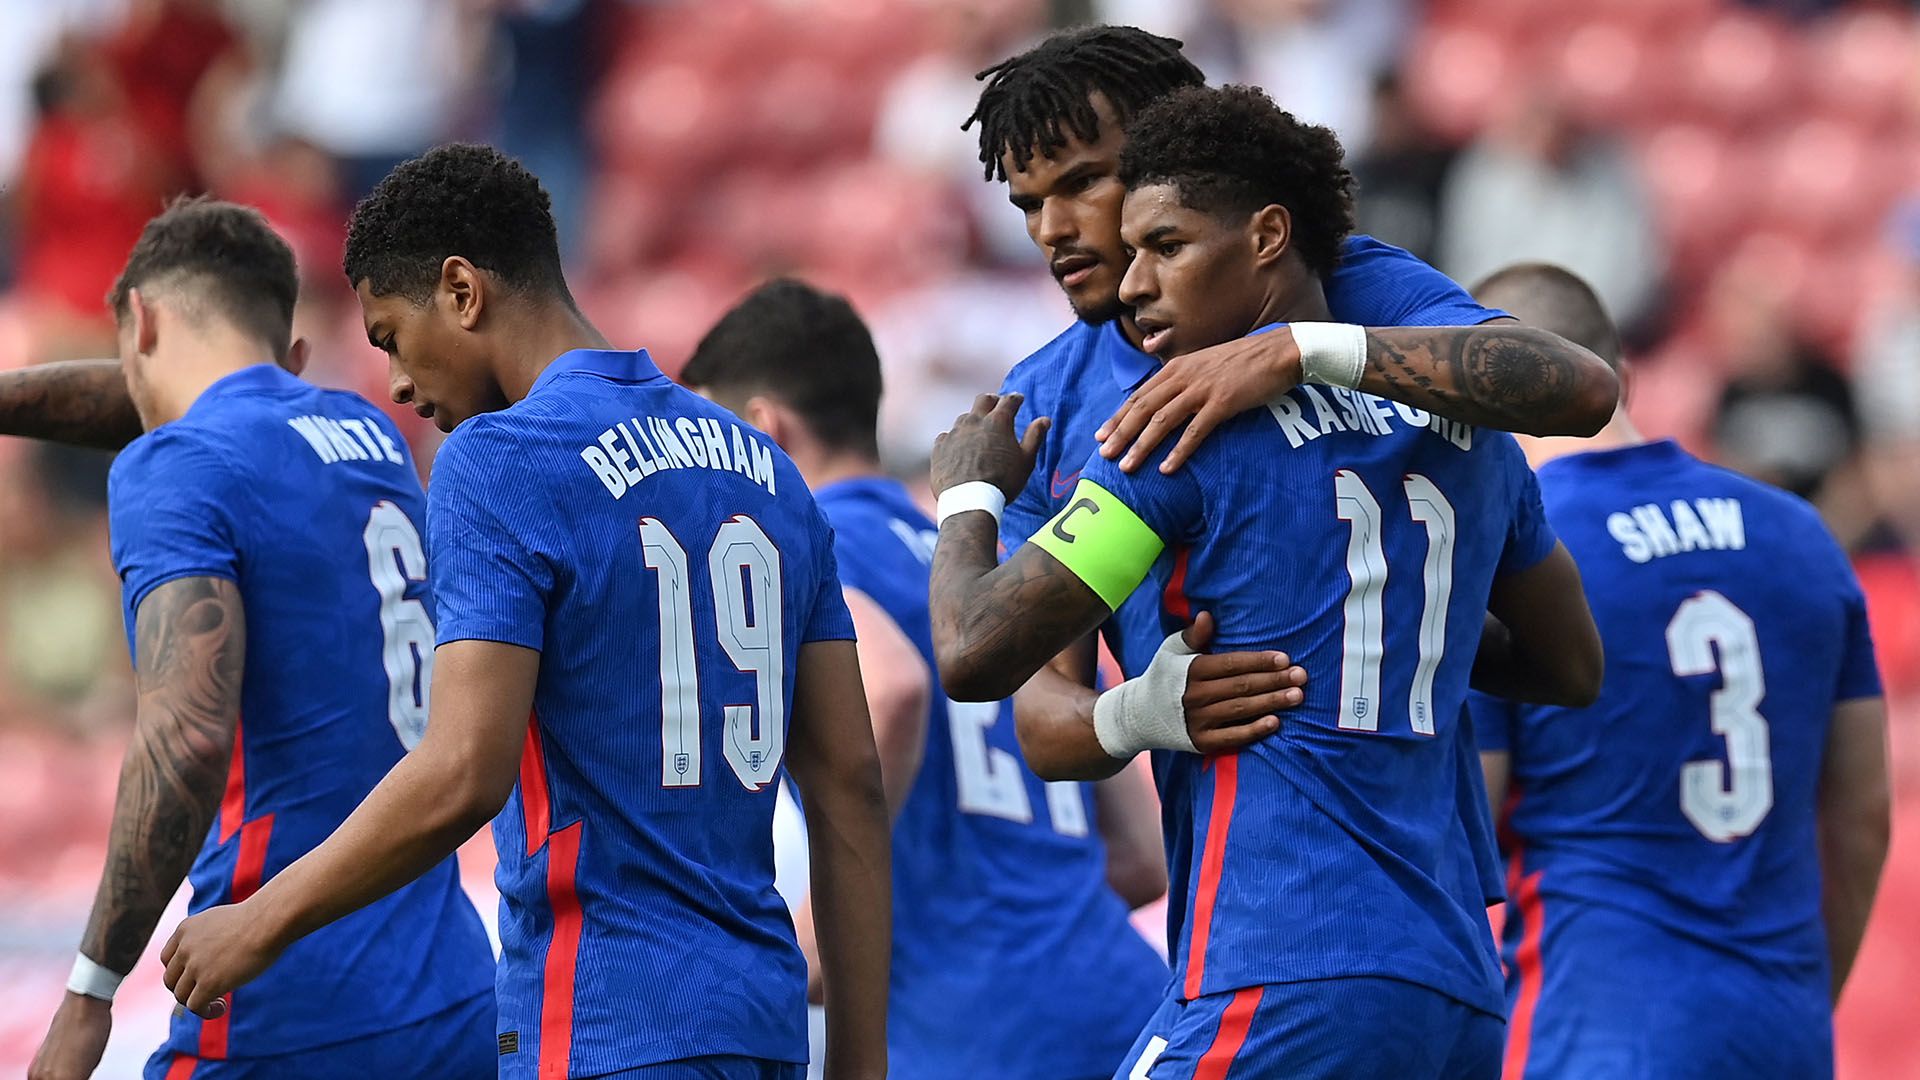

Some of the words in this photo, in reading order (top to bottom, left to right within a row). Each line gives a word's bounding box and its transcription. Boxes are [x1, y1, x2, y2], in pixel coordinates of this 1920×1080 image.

[287, 415, 405, 465] WHITE
[580, 416, 776, 500] BELLINGHAM
[1052, 497, 1101, 544] C
[1334, 468, 1456, 736] 11
[1606, 497, 1747, 564] SHAW
[363, 499, 435, 754] 6
[639, 514, 784, 792] 19
[1664, 588, 1775, 844] 3
